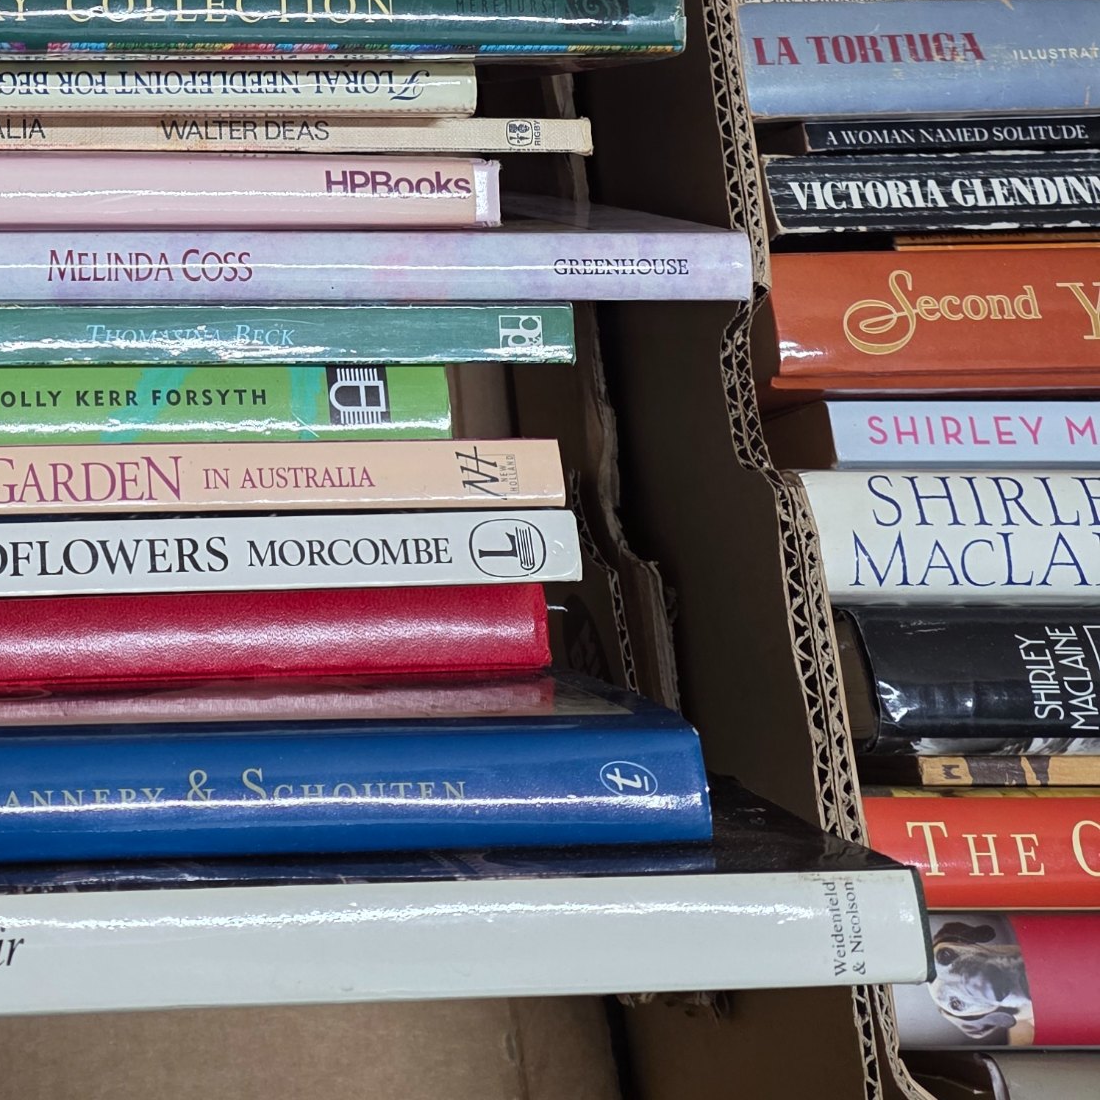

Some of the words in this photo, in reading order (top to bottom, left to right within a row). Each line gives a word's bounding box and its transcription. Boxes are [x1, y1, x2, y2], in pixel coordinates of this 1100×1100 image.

[752, 36, 801, 66] LA
[805, 31, 989, 66] TORTUGA
[59, 71, 108, 96] FOR
[117, 70, 301, 96] NEEDLEPOINT
[160, 119, 258, 143] WALTER
[264, 119, 330, 143] DEAS
[825, 131, 838, 146] A
[840, 129, 916, 146] WOMAN
[920, 126, 989, 143] NAMED
[993, 124, 1089, 141] SOLITUDE
[324, 169, 472, 197] HPBooks
[787, 178, 949, 212] VICTORIA
[47, 248, 171, 283] MELINDA
[181, 247, 254, 282] COSS
[553, 258, 690, 276] GREENHOUSE
[842, 269, 1043, 356] Second
[75, 389, 139, 408] KERR
[151, 388, 268, 408] FORSYTH
[866, 415, 1044, 446] SHIRLEY
[202, 468, 231, 492] IN
[240, 466, 377, 491] AUSTRALIA
[246, 536, 454, 569] MORCOMBE
[904, 820, 1045, 877] THE
[845, 880, 865, 956] Nicolson
